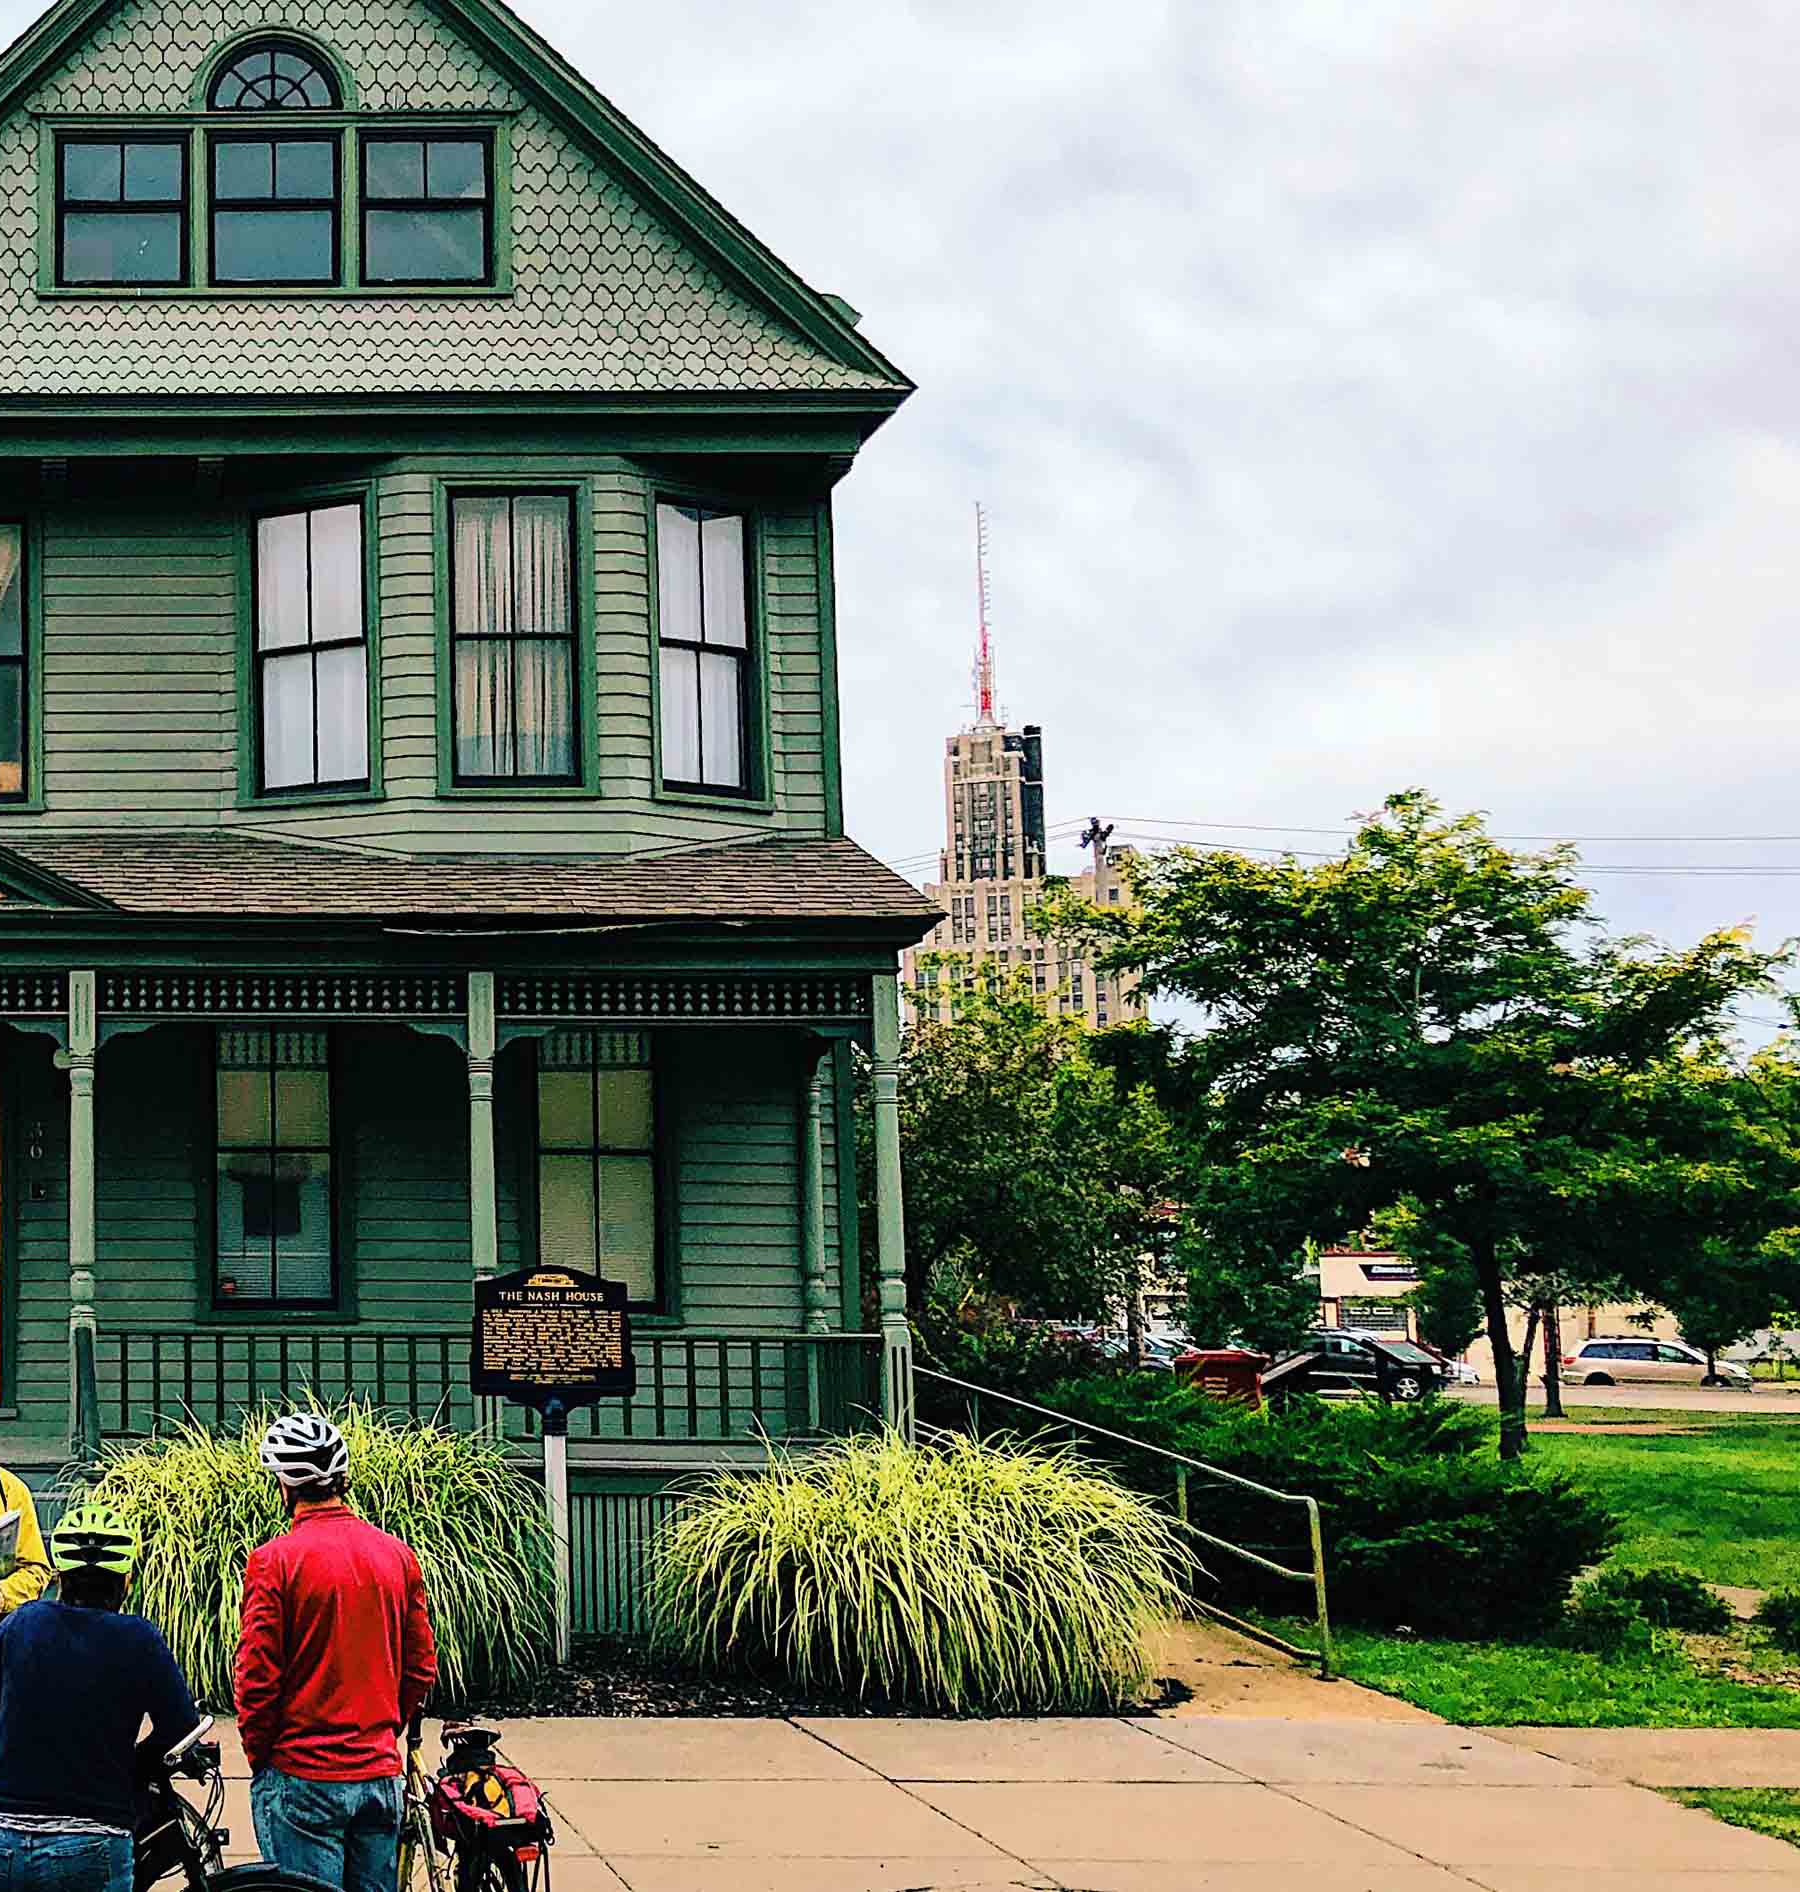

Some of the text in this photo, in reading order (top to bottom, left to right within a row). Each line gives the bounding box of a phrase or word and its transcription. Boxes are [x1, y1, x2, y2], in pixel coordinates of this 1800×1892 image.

[498, 1291, 604, 1302] THE NASH HOUSE
